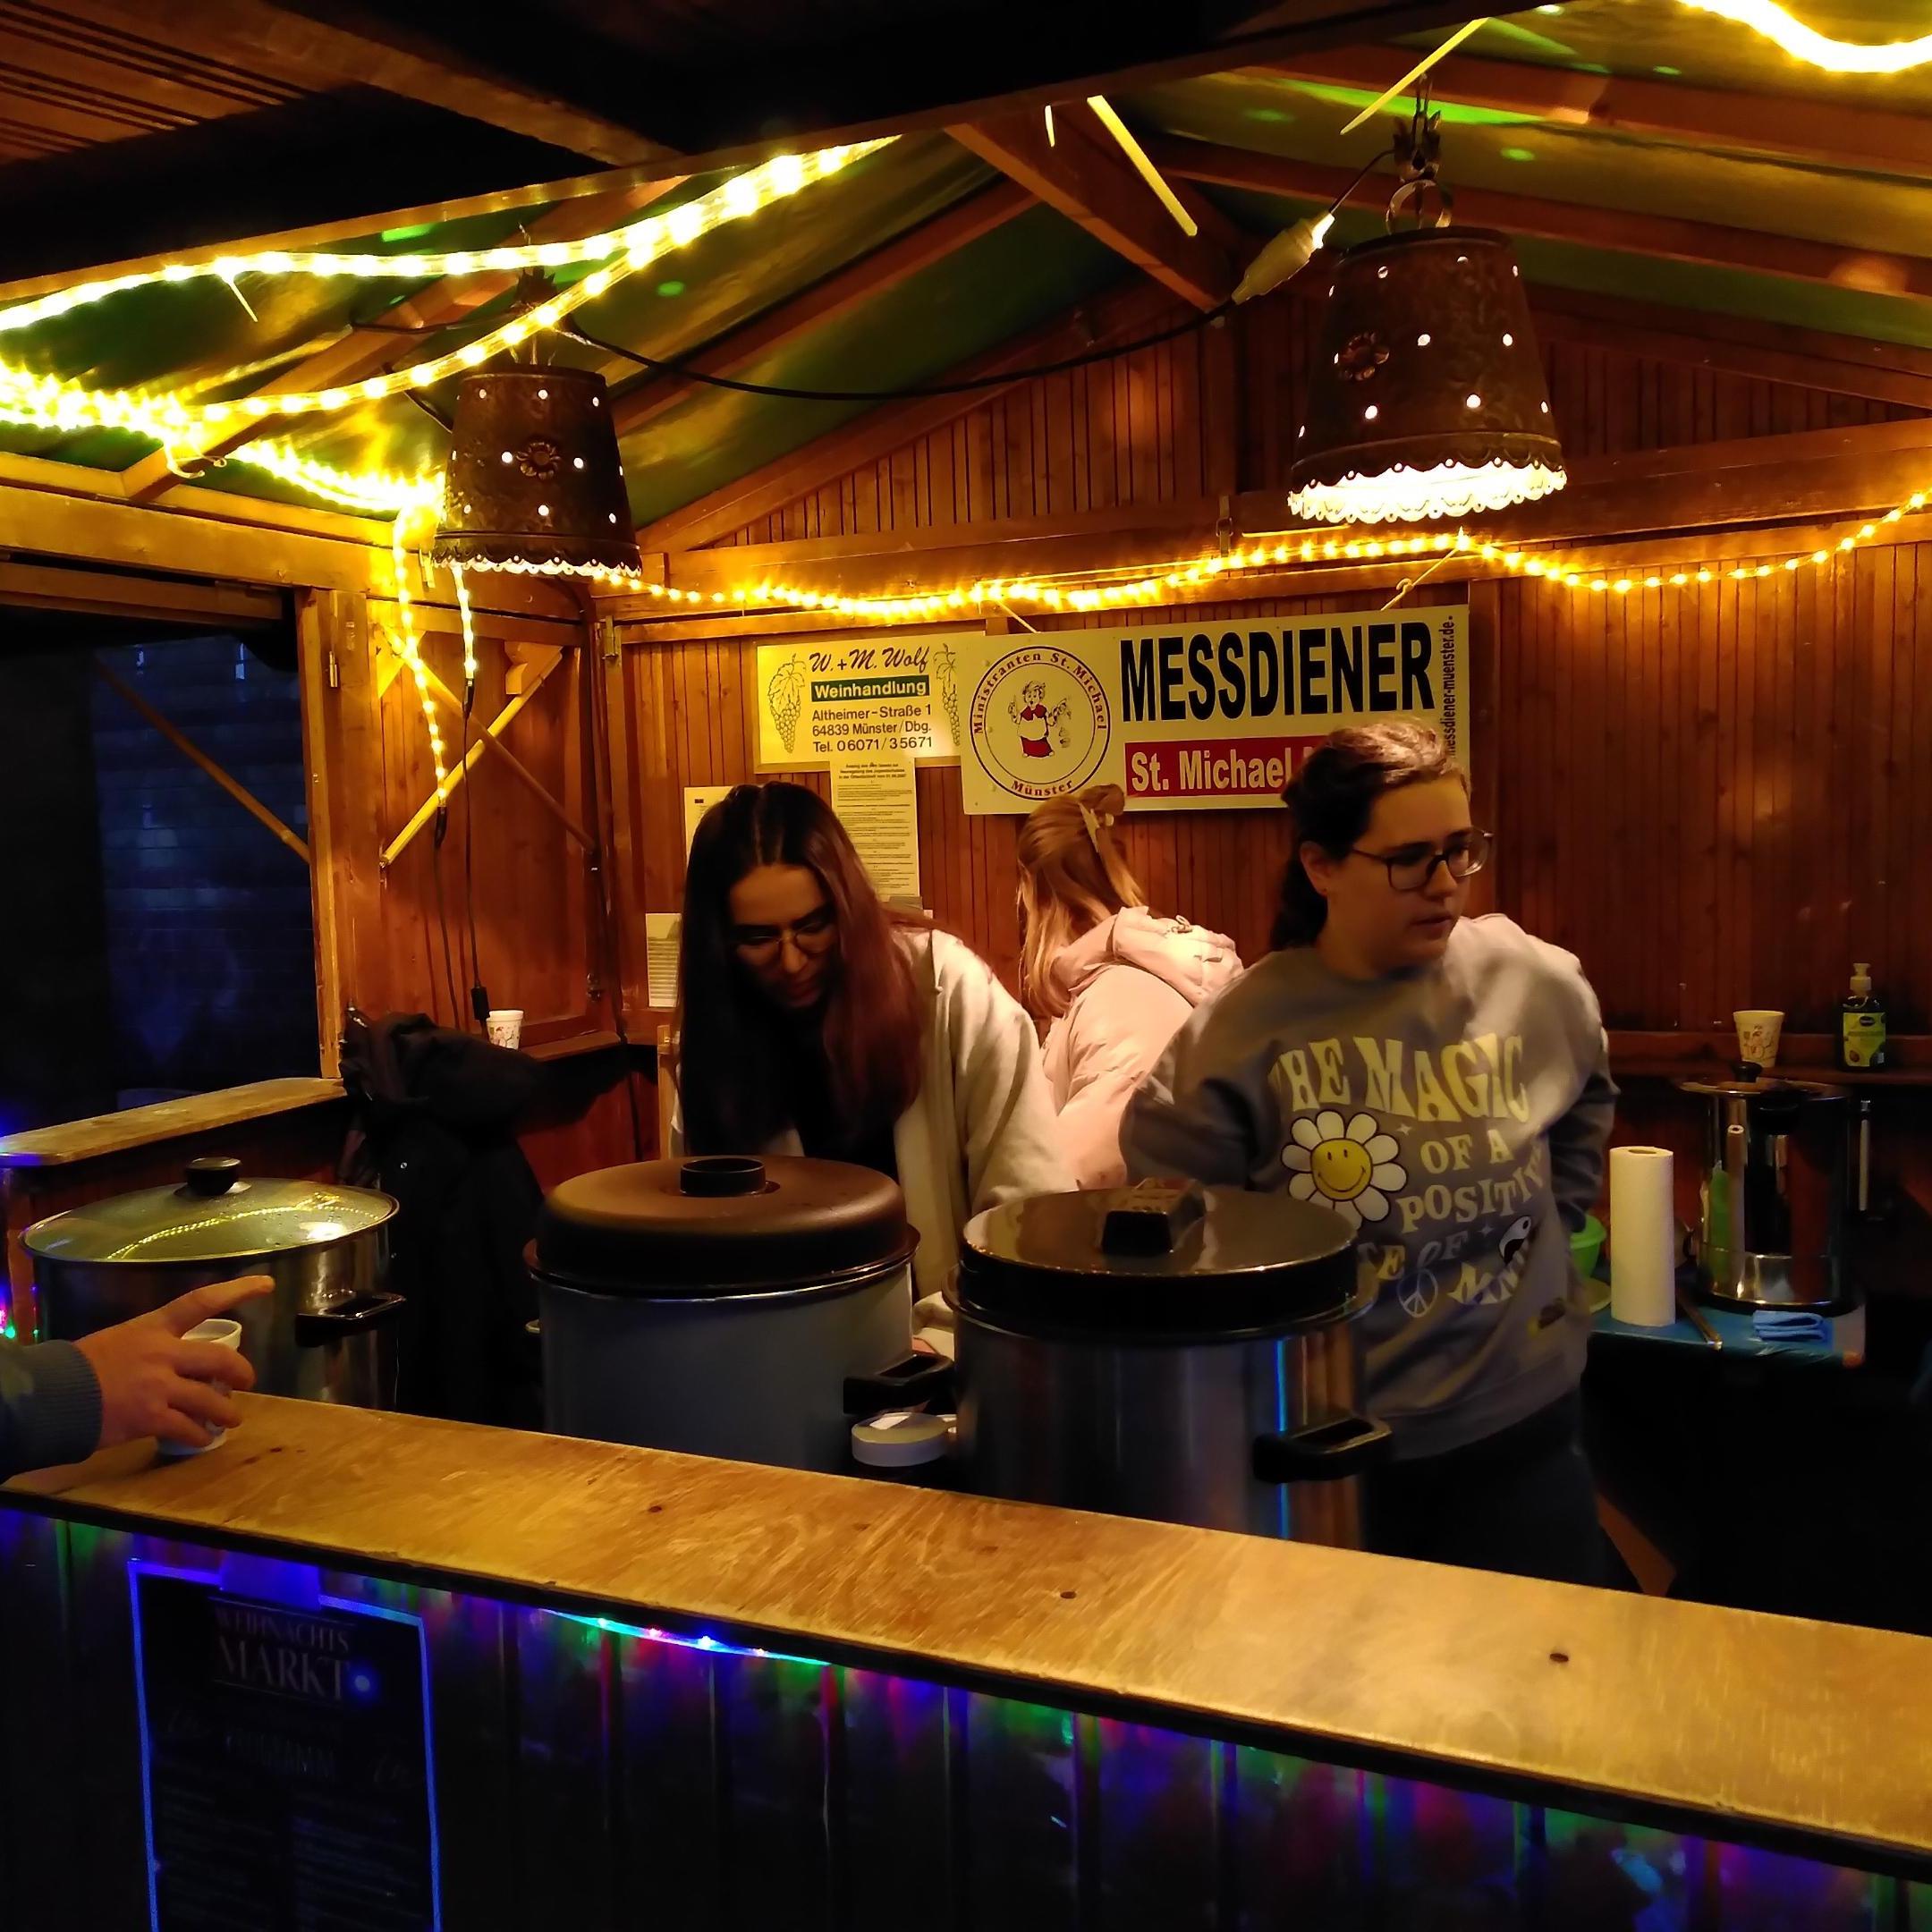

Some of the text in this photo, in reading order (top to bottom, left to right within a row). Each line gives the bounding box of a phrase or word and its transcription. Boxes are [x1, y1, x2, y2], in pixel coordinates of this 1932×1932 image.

[882, 646, 930, 674] Wolf
[1120, 621, 1435, 723] MESSDIENER
[814, 681, 927, 699] Weinhandlung
[973, 652, 1107, 734] Ministranten St. Michael
[926, 704, 932, 716] 1
[812, 722, 850, 737] 64839
[813, 741, 834, 752] Tel.
[1011, 779, 1073, 797] Münster
[1131, 747, 1292, 792] St. Michael
[1352, 1032, 1530, 1123] MAGIC
[1419, 1129, 1515, 1174] OF A
[1417, 1231, 1469, 1268] OF
[218, 1634, 351, 1700] MARKT
